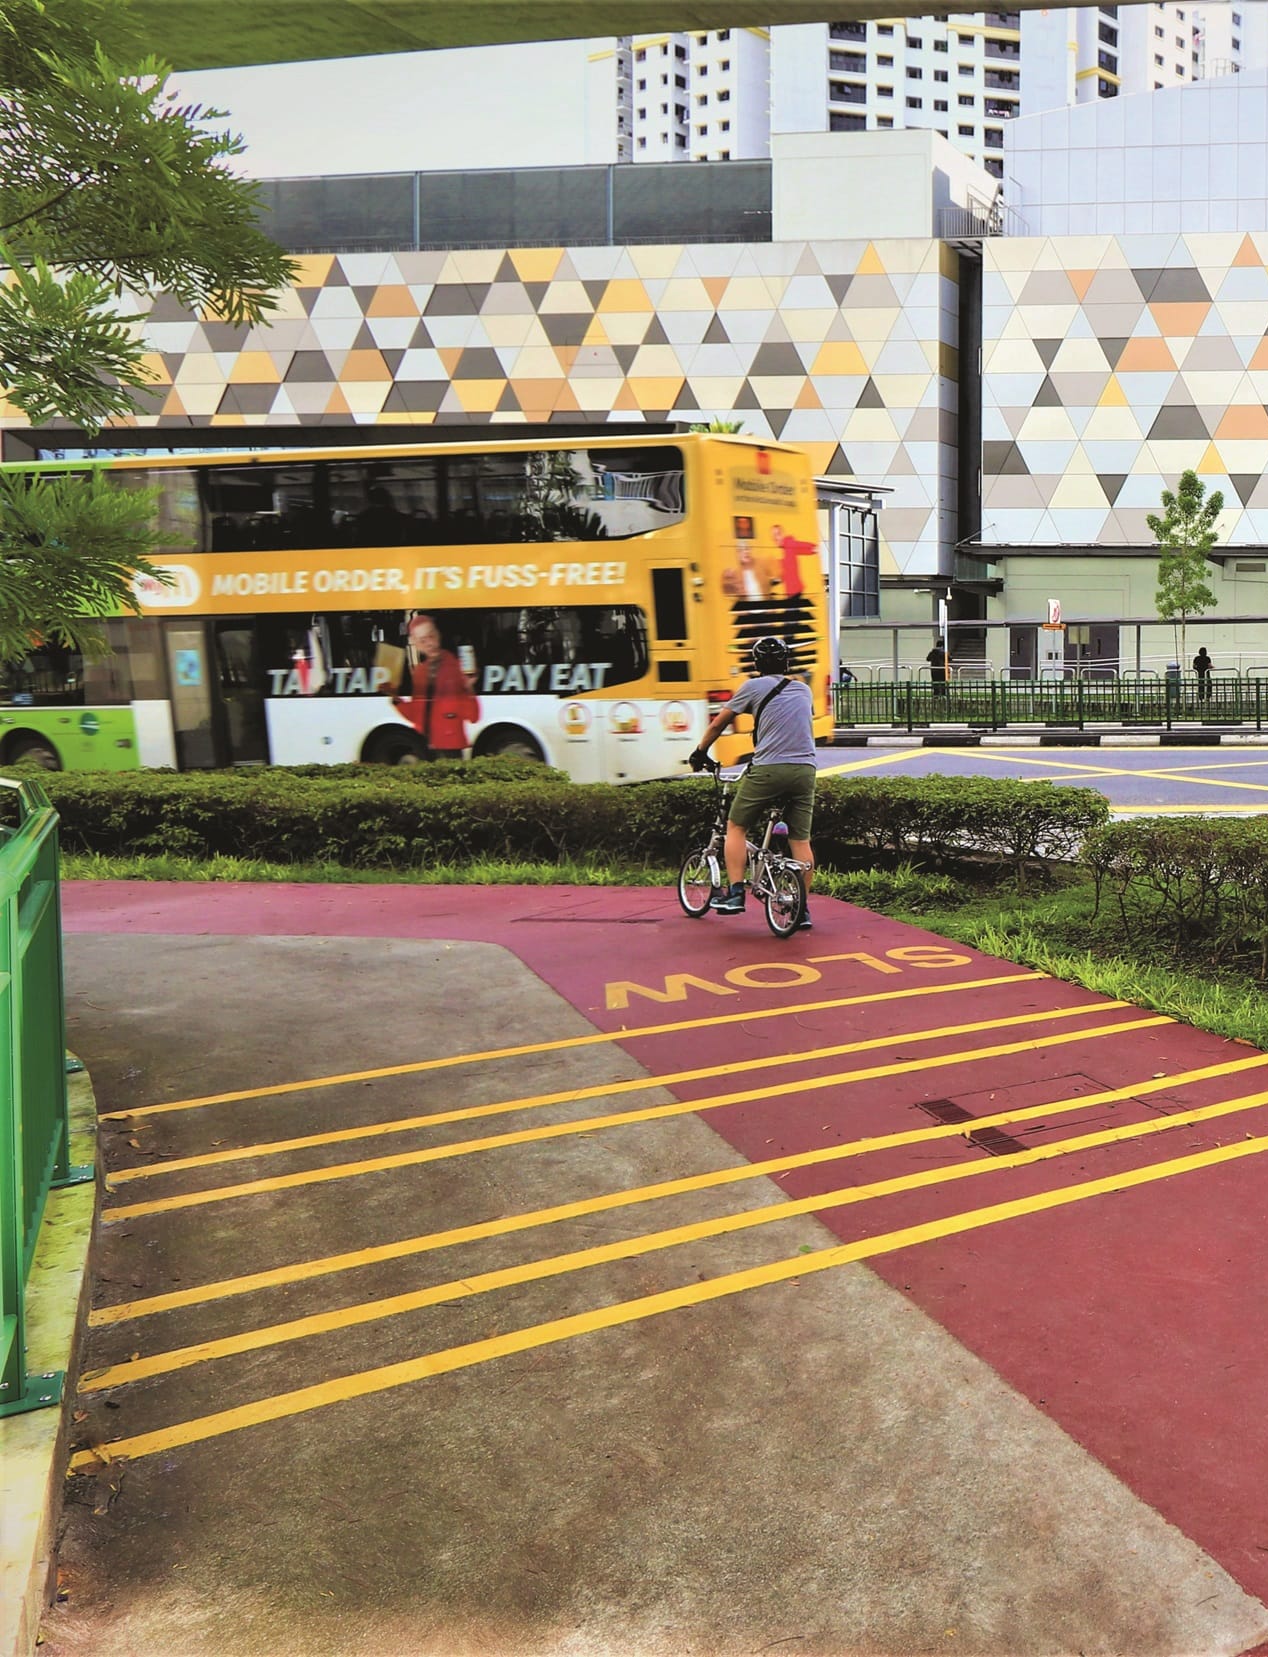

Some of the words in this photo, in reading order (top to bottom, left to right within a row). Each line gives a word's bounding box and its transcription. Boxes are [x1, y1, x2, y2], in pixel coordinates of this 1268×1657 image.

[211, 570, 309, 597] MOBILE
[313, 568, 411, 595] ORDER,
[414, 564, 464, 591] IT'S
[466, 560, 628, 590] FUSS-FREE!
[331, 667, 393, 694] TAP
[482, 664, 548, 692] PAY
[550, 662, 614, 691] EAT
[604, 945, 973, 1010] SLOW
